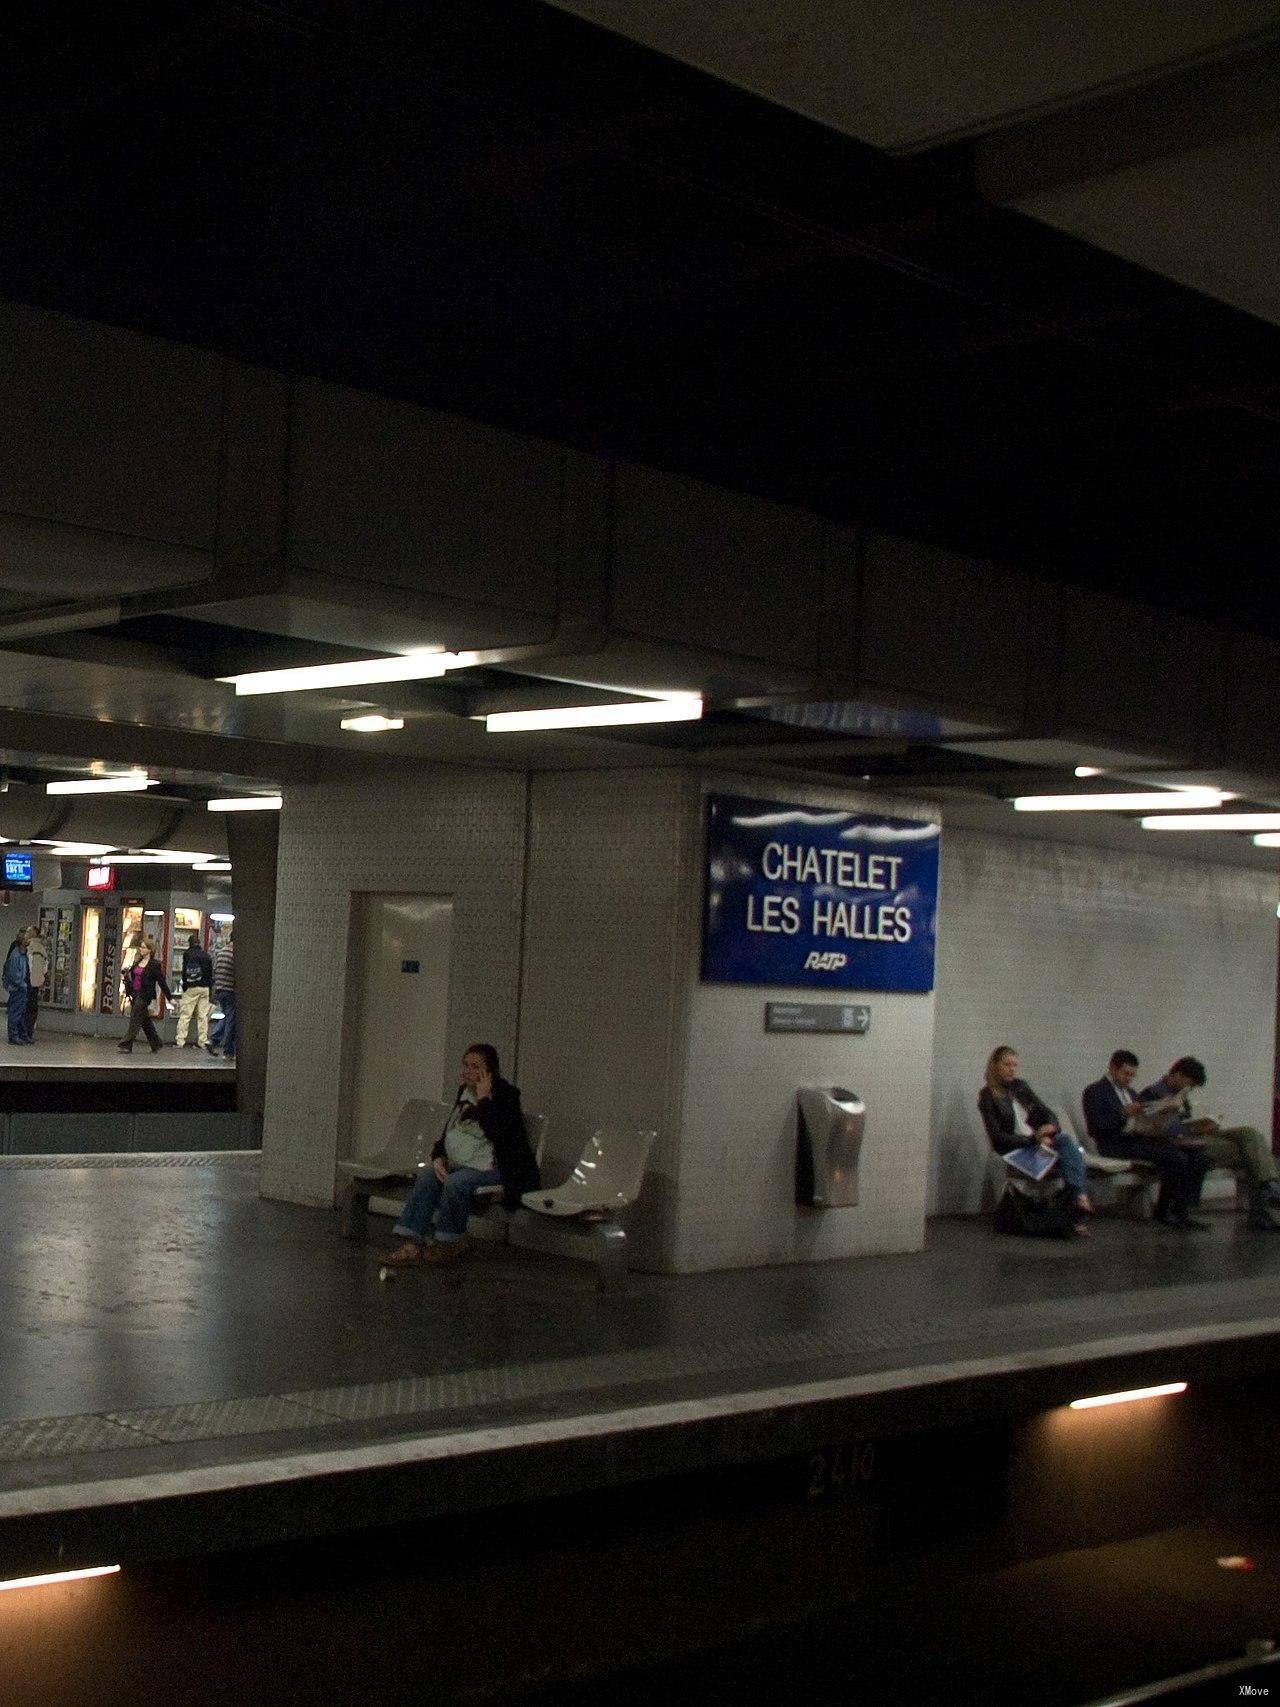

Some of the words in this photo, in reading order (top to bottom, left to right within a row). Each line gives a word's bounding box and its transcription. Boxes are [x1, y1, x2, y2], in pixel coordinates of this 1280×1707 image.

[762, 842, 902, 889] CHATELET
[747, 894, 800, 935] LES
[813, 900, 912, 942] HALLES
[804, 951, 847, 970] RATP
